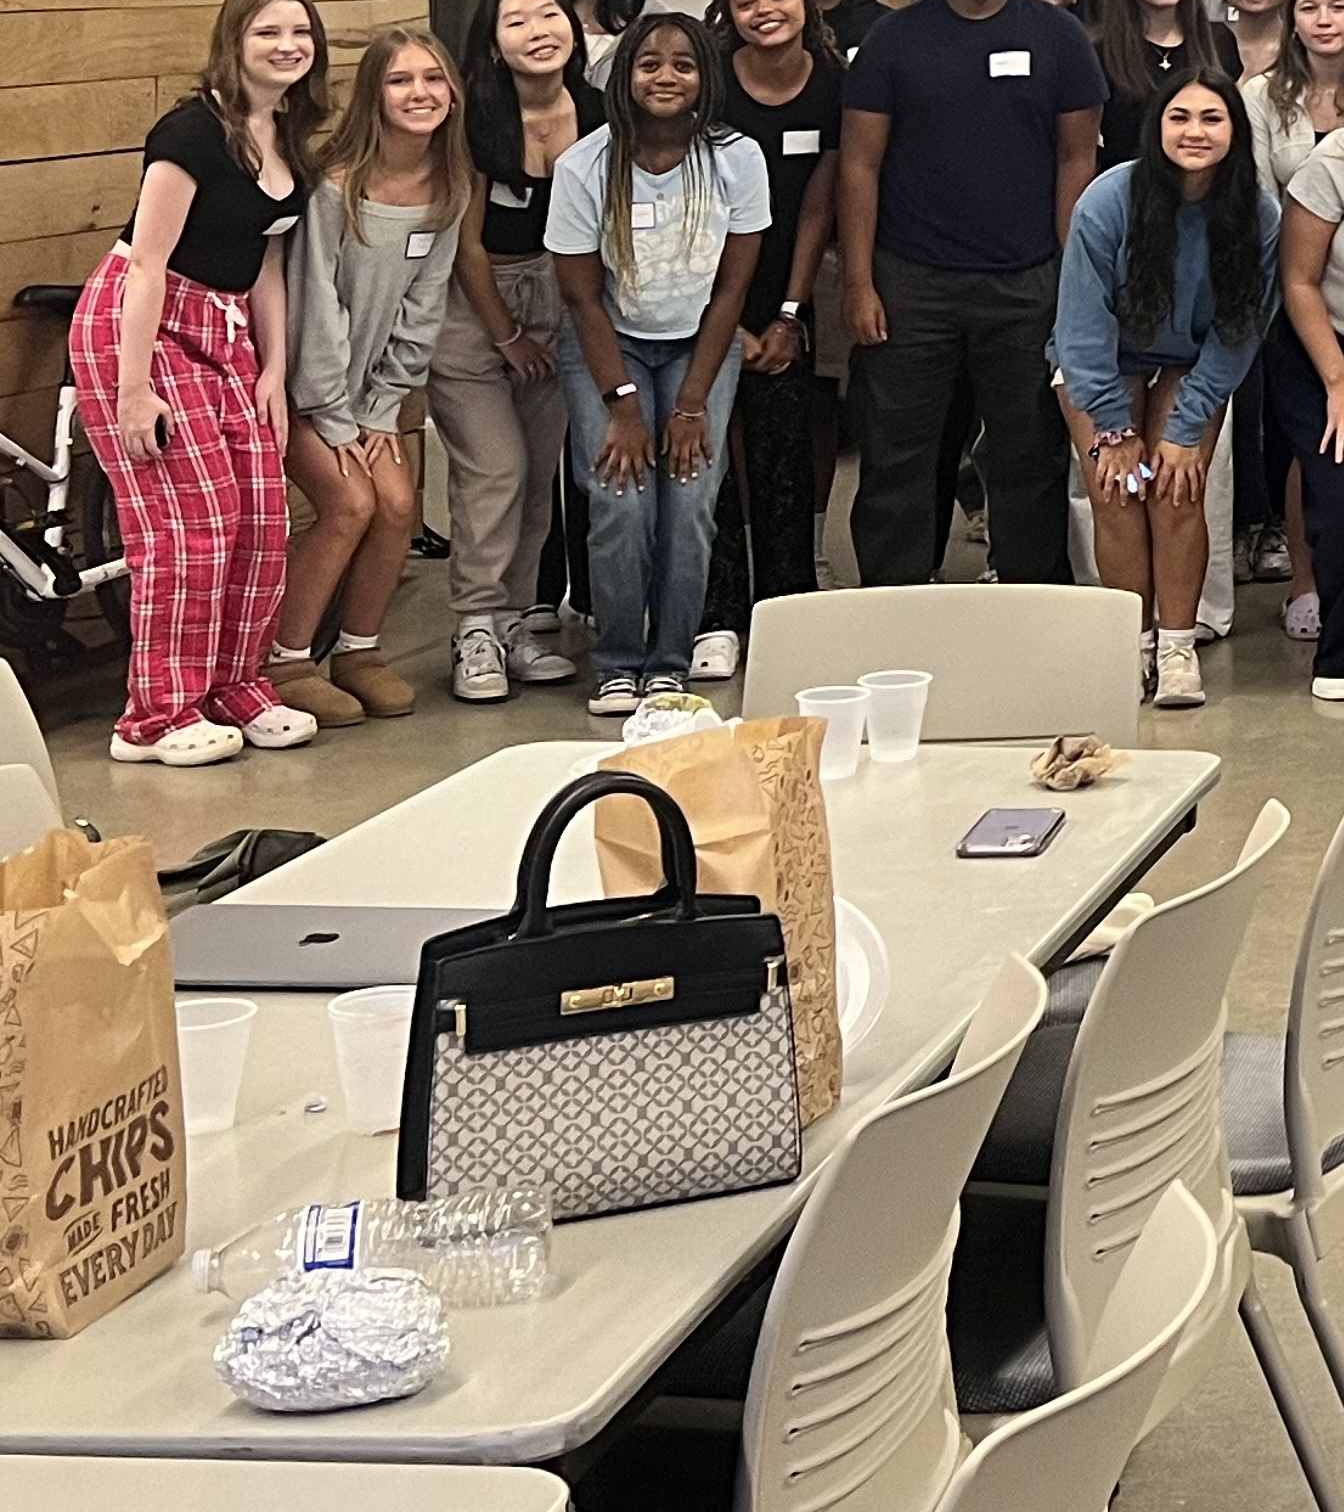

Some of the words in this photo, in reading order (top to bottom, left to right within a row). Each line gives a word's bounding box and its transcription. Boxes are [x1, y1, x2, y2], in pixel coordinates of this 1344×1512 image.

[45, 1100, 175, 1222] CHIPS
[48, 1064, 168, 1161] HANDCRAFTED
[59, 1228, 139, 1308] EVERY
[142, 1201, 178, 1260] DAY
[67, 1211, 101, 1254] MADE
[111, 1167, 171, 1233] FRESH
